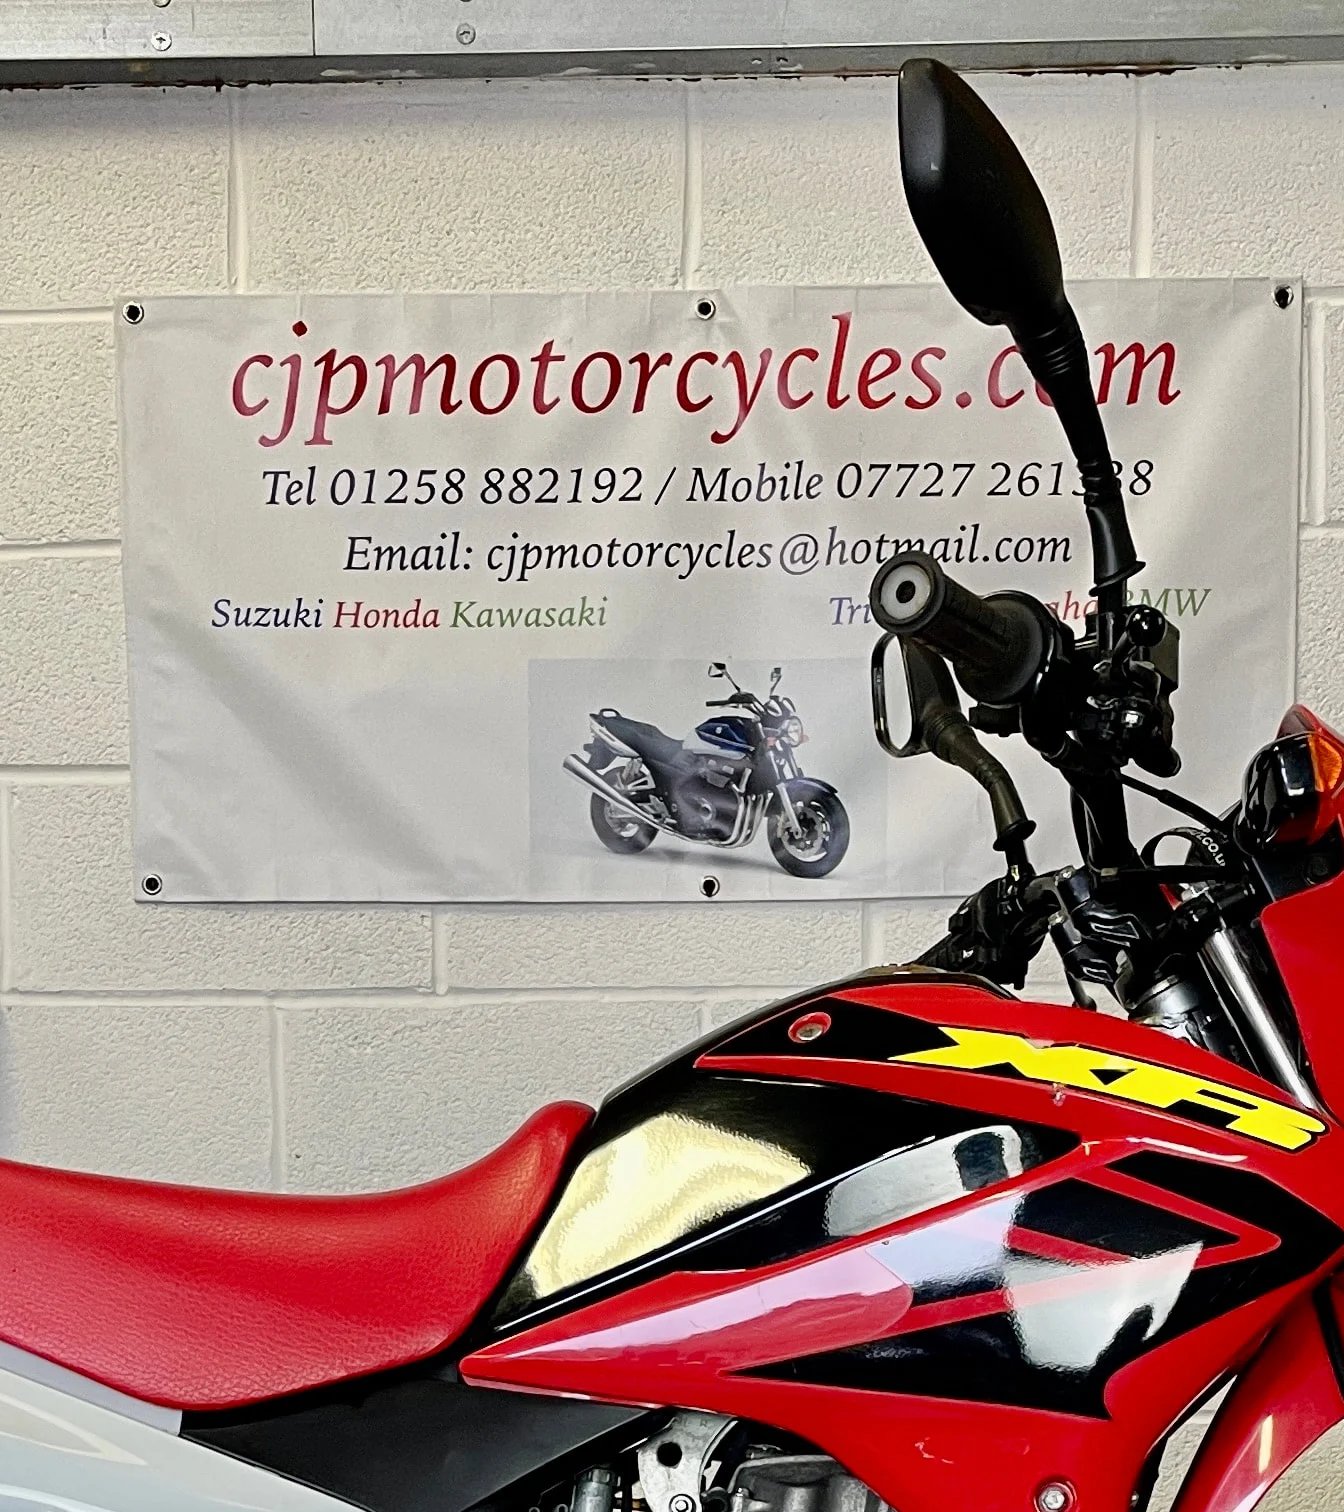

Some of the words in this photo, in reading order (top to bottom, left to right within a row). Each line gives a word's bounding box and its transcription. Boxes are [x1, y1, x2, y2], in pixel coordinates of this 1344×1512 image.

[231, 312, 1182, 448] cjpmotorcycles.cm
[262, 466, 316, 505] Tel
[330, 467, 466, 505] 01258
[479, 467, 643, 505] 882192
[654, 467, 676, 505] /
[685, 460, 824, 502] Mobile
[836, 462, 977, 500] 07727
[343, 531, 473, 572] Email:
[487, 523, 1073, 583] cjpmotorcycles@hotmail.com
[211, 597, 324, 629] Suzuki
[333, 597, 441, 629] Honda
[449, 595, 609, 629] Kawasaki
